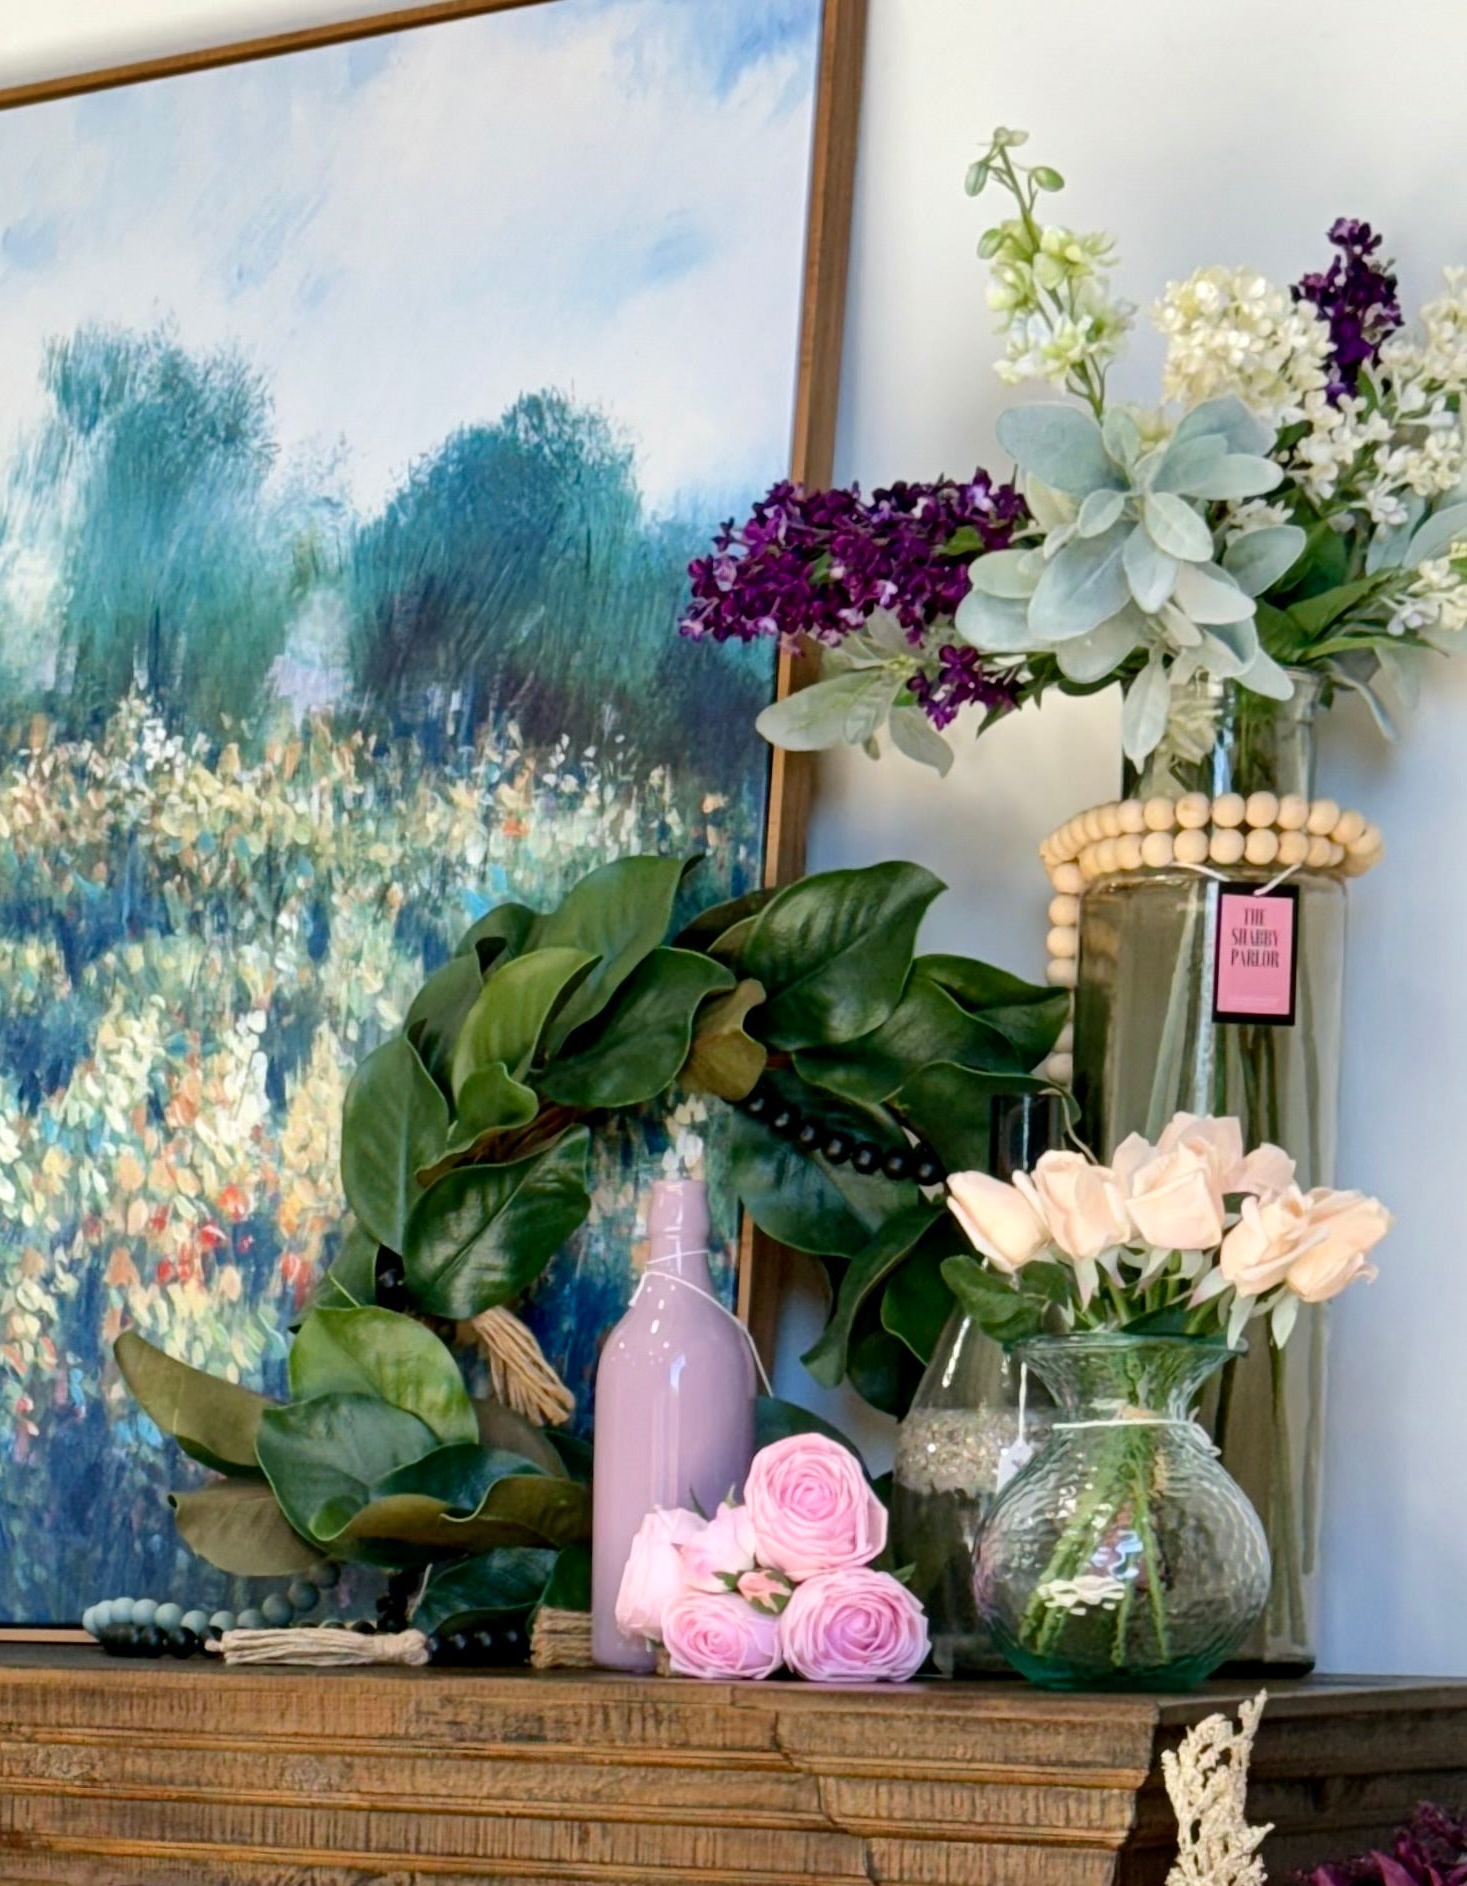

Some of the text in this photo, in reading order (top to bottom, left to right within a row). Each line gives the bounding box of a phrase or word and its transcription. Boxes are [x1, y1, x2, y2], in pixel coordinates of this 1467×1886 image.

[1244, 908, 1265, 926] THE
[1232, 928, 1279, 947] SHABBY
[1231, 948, 1280, 968] PARLOR
